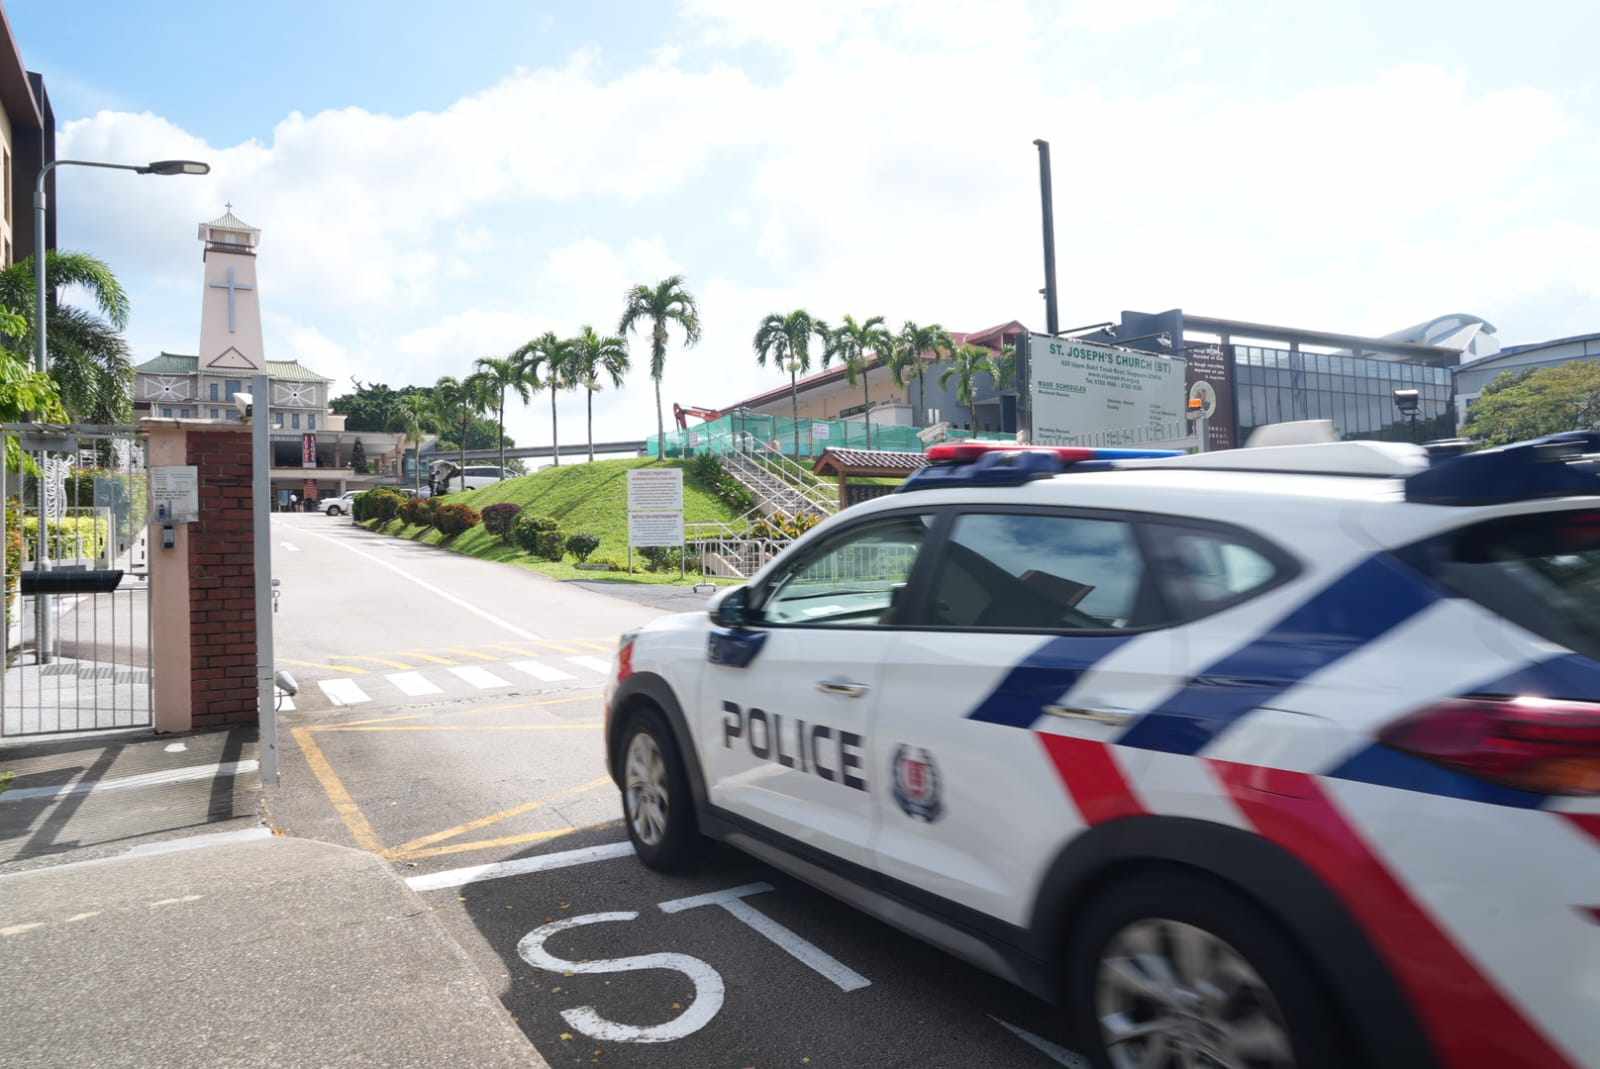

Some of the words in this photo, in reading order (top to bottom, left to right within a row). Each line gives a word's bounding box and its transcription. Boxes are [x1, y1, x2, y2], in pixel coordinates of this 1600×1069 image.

[1049, 343, 1065, 356] ST.
[1067, 347, 1113, 364] JOSEPH'S
[1115, 355, 1152, 370] CHURCH
[722, 700, 868, 792] POLICE
